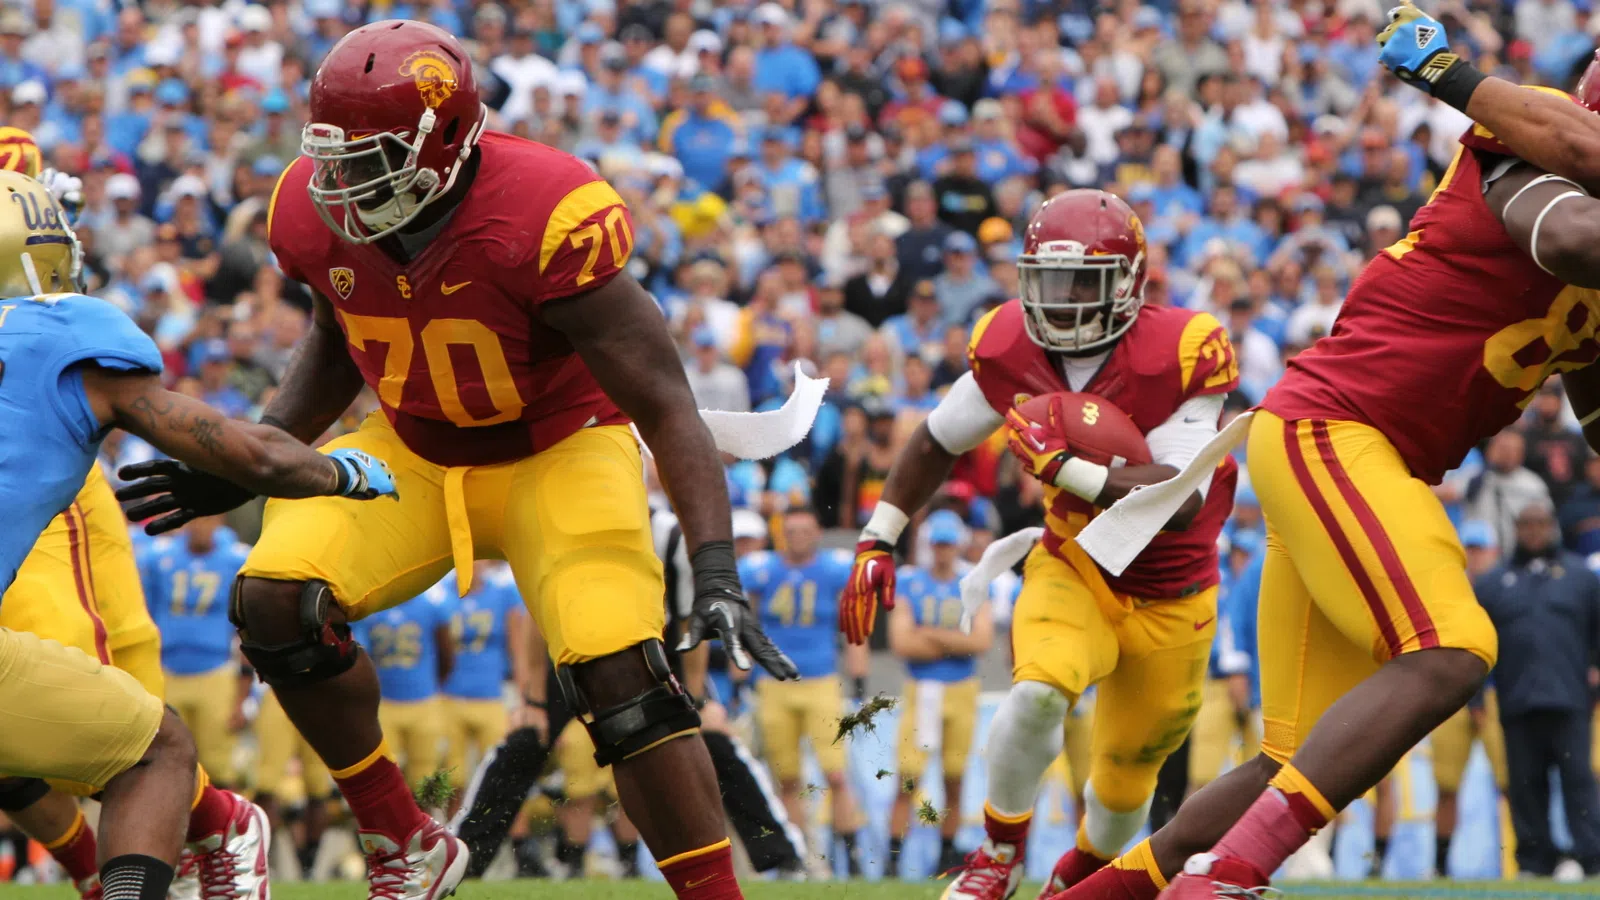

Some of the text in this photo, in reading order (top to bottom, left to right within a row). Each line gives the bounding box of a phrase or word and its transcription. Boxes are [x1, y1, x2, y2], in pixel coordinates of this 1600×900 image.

[11, 191, 63, 230] Ucl
[569, 206, 633, 287] 70
[337, 280, 350, 293] 12
[338, 308, 527, 428] 70
[170, 569, 222, 617] 17
[768, 581, 818, 626] 41
